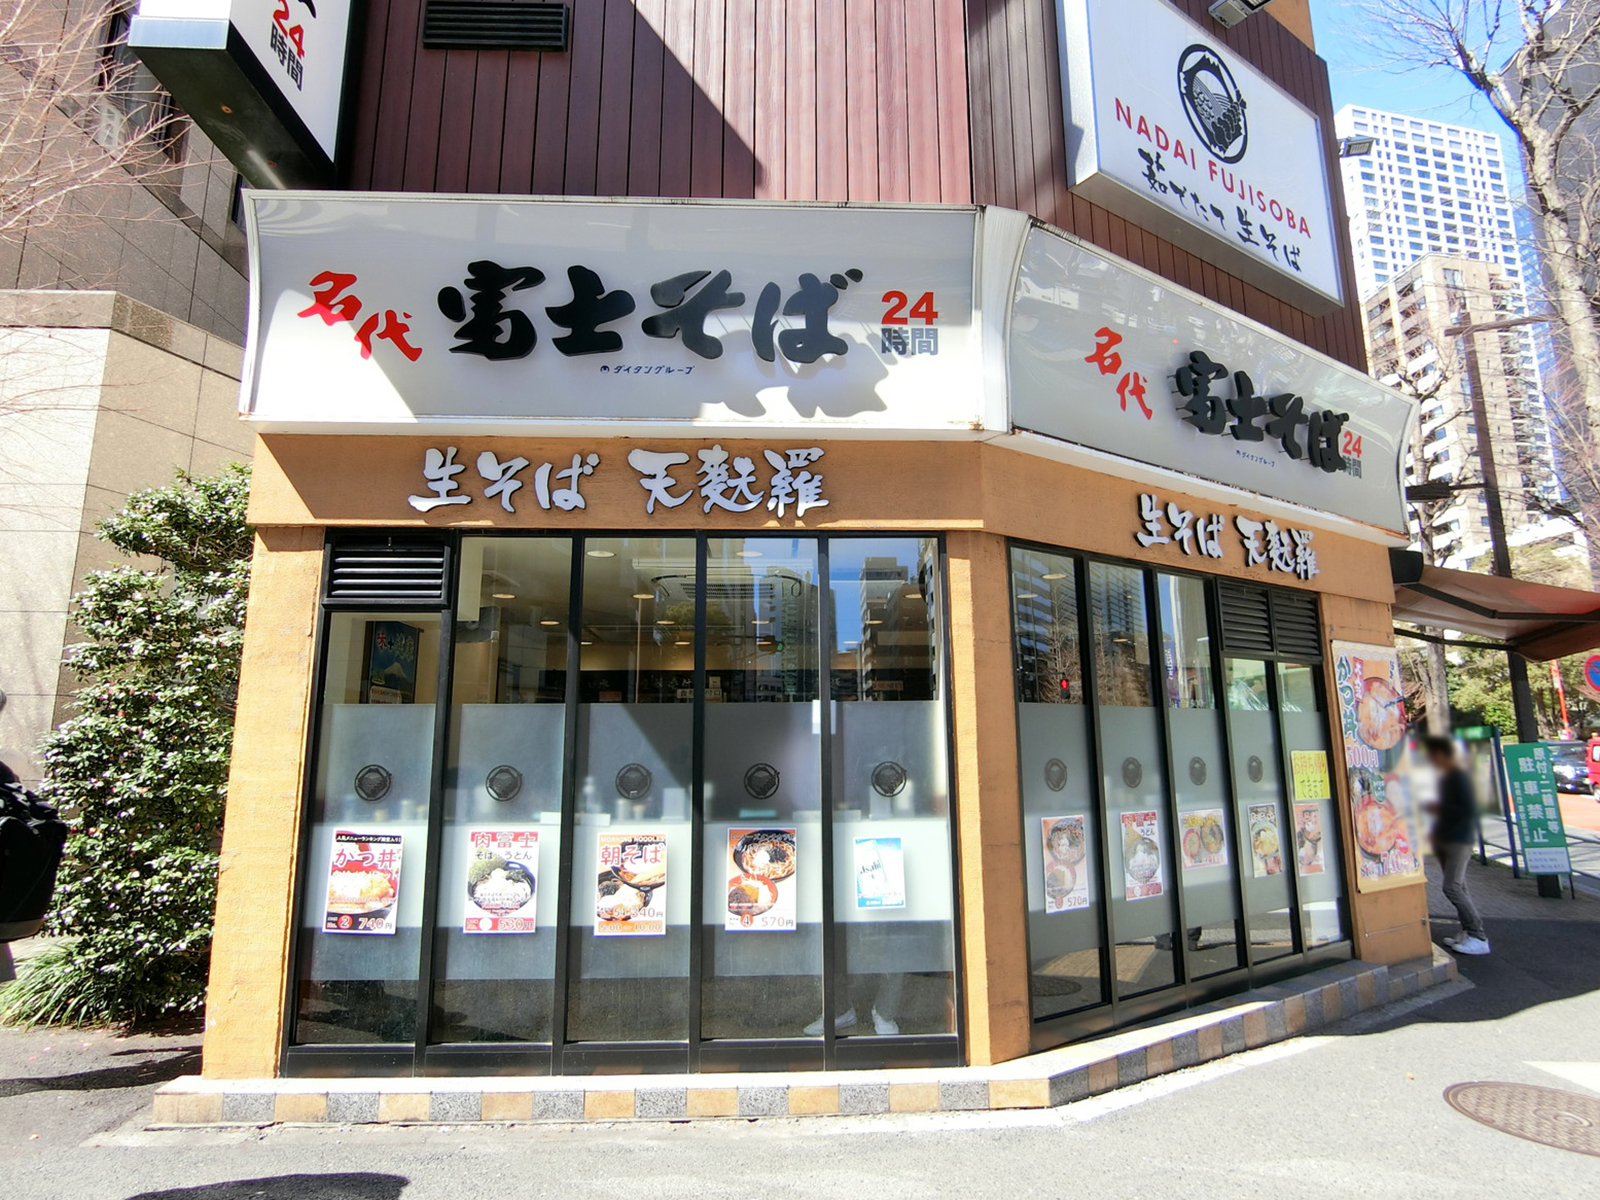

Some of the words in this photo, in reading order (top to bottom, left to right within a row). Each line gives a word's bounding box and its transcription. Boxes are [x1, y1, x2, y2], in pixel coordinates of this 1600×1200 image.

[270, 21, 304, 91] 時間
[273, 0, 305, 60] 24
[1115, 97, 1197, 171] NADAI
[1208, 159, 1312, 239] FUJISOBA
[1236, 206, 1303, 273] 生そば
[297, 270, 423, 362] 名代
[437, 260, 864, 364] 富士そば
[881, 290, 939, 326] 24
[613, 364, 696, 375] ダイタングループ
[881, 327, 939, 356] 時間
[1084, 326, 1153, 420] 名代
[1174, 350, 1350, 473] 富士そば
[1342, 430, 1363, 458] 24
[406, 445, 601, 514] 生そば
[1135, 493, 1225, 559] 生そば
[1517, 756, 1549, 843] 駐車禁止
[475, 831, 535, 848] 肉富士
[600, 845, 665, 865] 朝そば
[743, 915, 751, 926] 4
[761, 916, 795, 927] 570円
